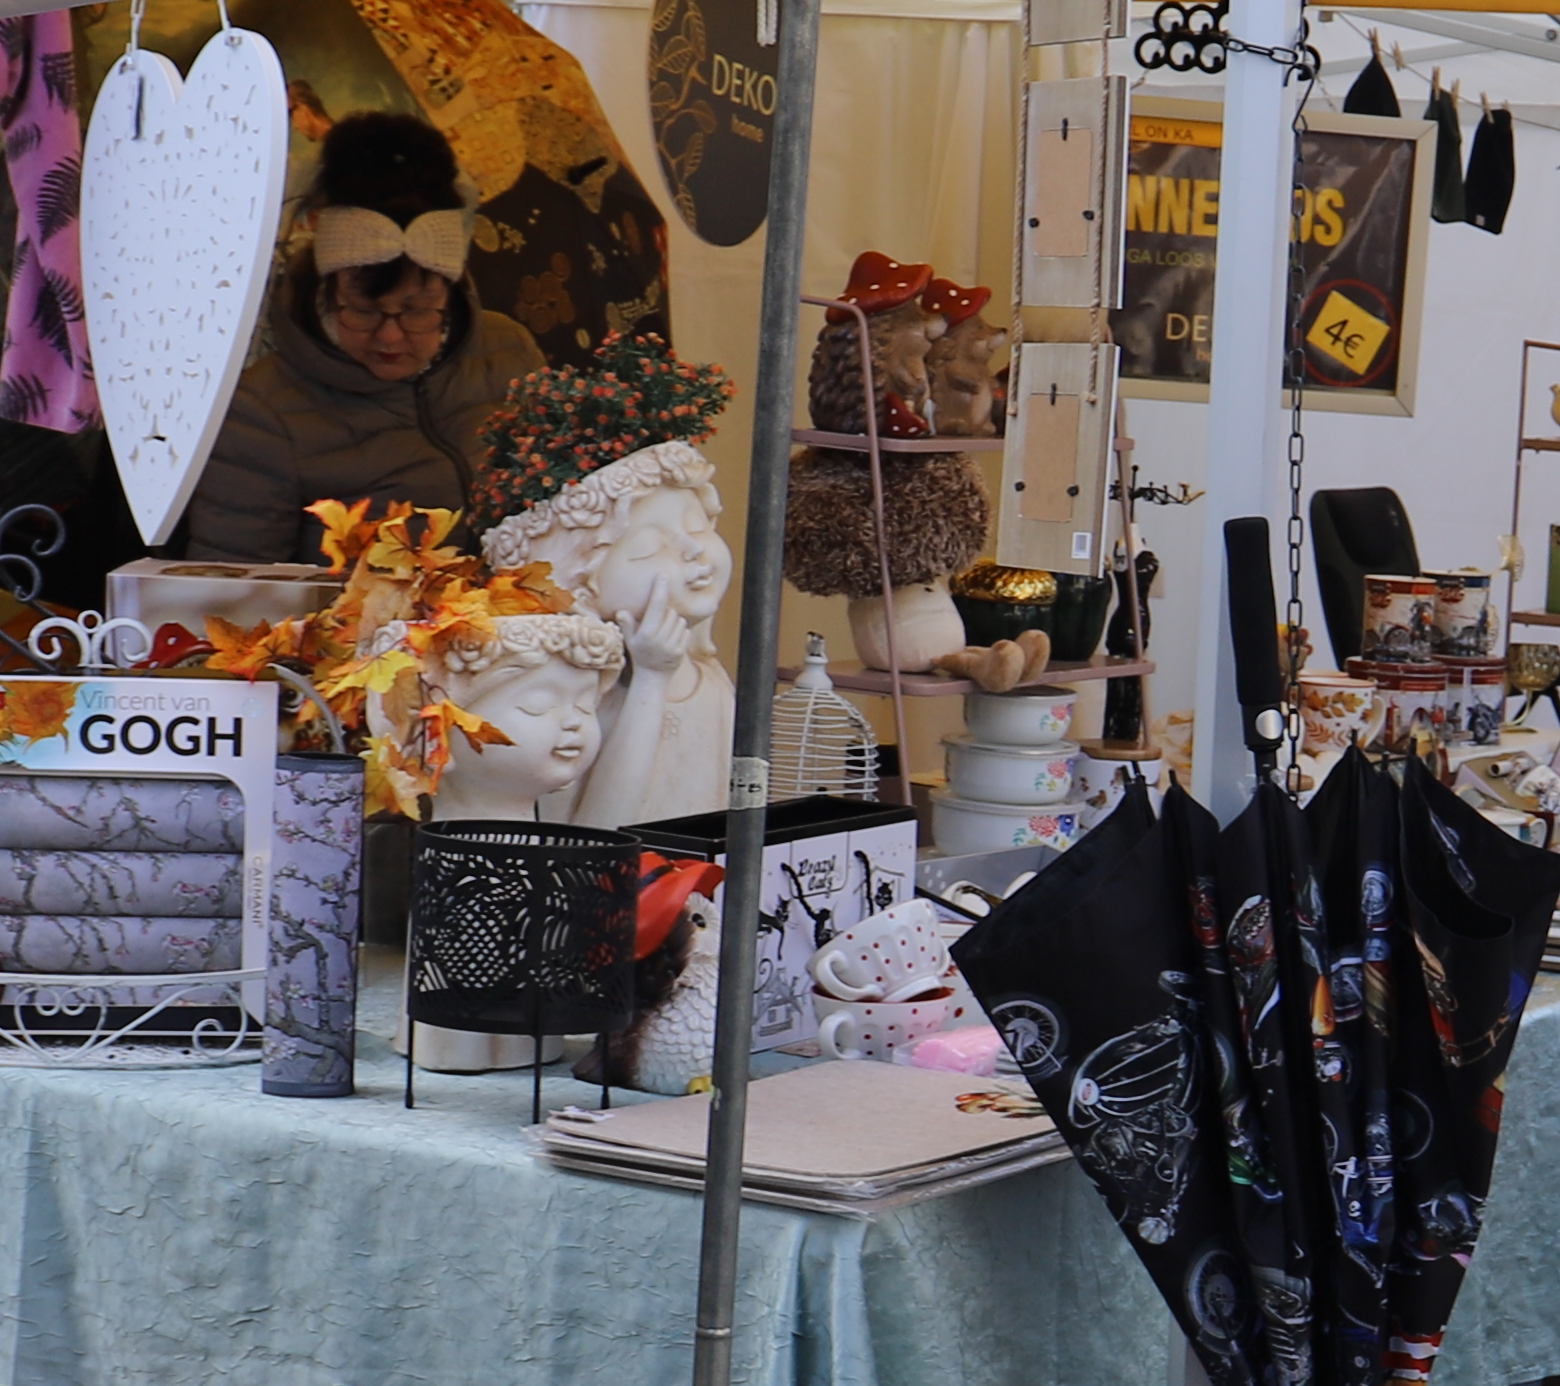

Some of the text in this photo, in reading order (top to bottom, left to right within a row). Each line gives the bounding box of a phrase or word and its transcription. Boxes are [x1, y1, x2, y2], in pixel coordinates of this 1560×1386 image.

[712, 53, 778, 115] DEKO
[1145, 124, 1168, 137] ON
[1173, 127, 1194, 140] KA
[1127, 247, 1205, 266] GA LOOS
[1165, 311, 1209, 341] DE
[1323, 318, 1365, 359] 4€
[80, 689, 210, 712] Vincent van
[79, 714, 243, 757] GOGH
